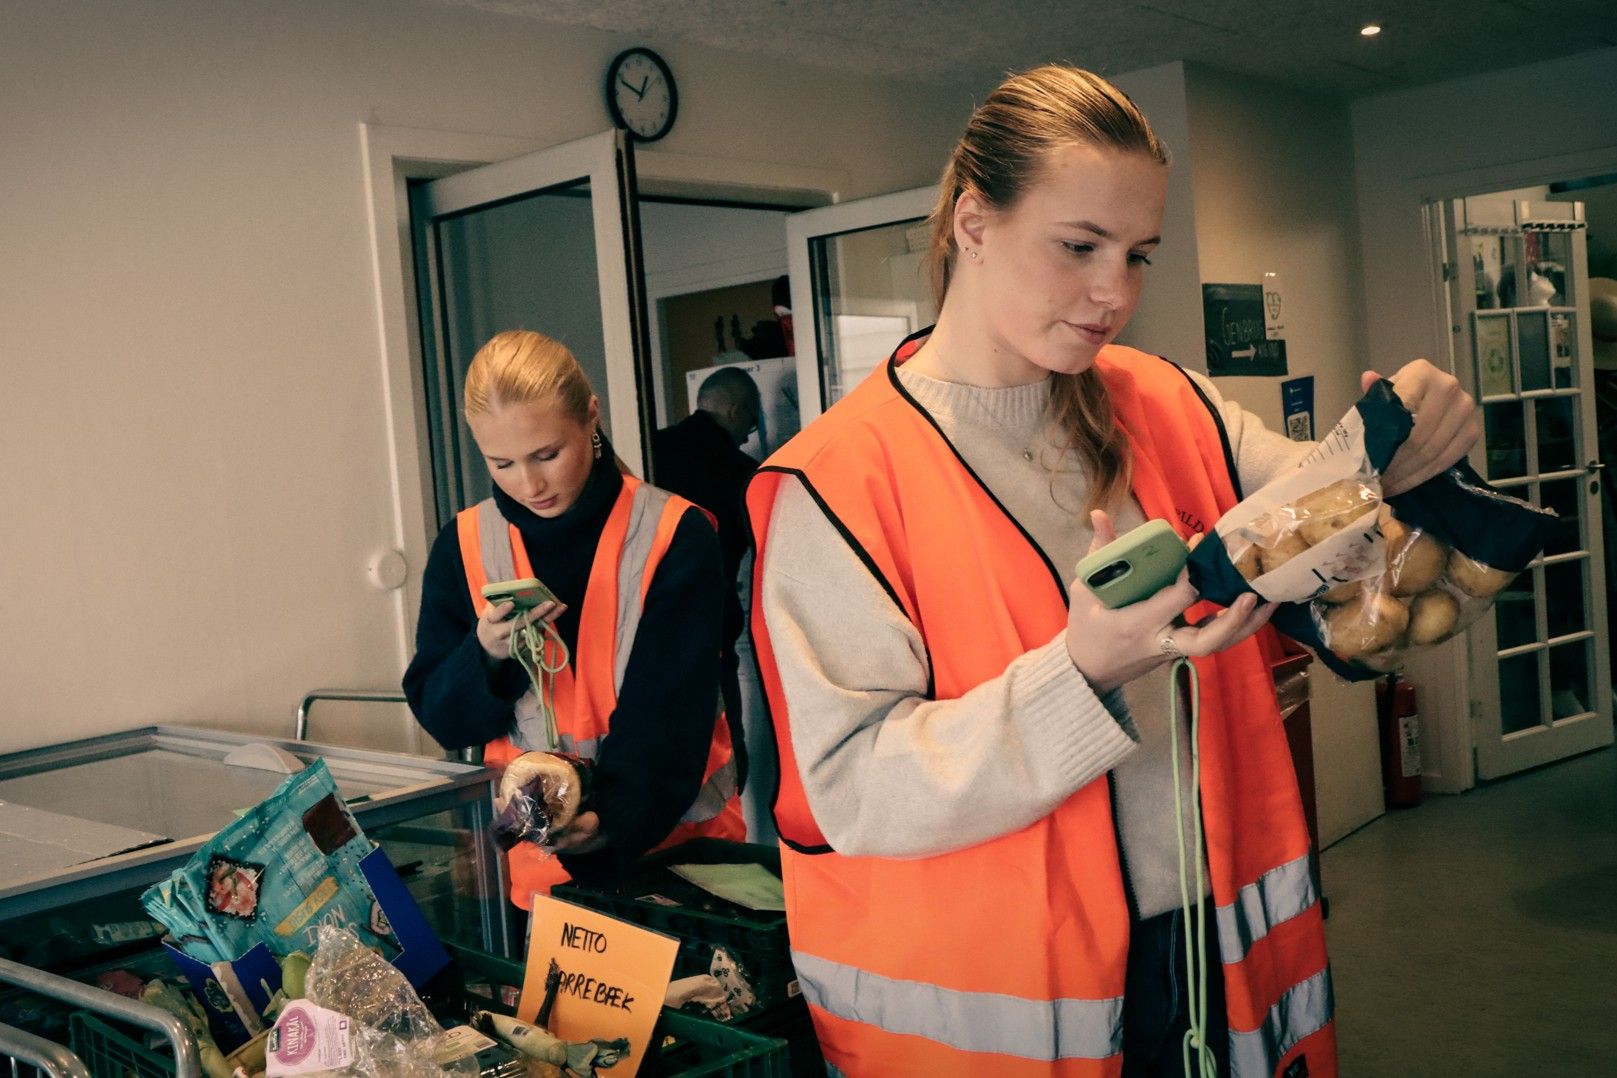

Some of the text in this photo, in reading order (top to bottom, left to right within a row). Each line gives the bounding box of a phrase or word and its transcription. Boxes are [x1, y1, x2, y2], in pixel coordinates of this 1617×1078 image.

[560, 922, 607, 953] NETTO
[553, 970, 635, 1013] ARREBÆK
[287, 1015, 300, 1056] KINAKÅL
